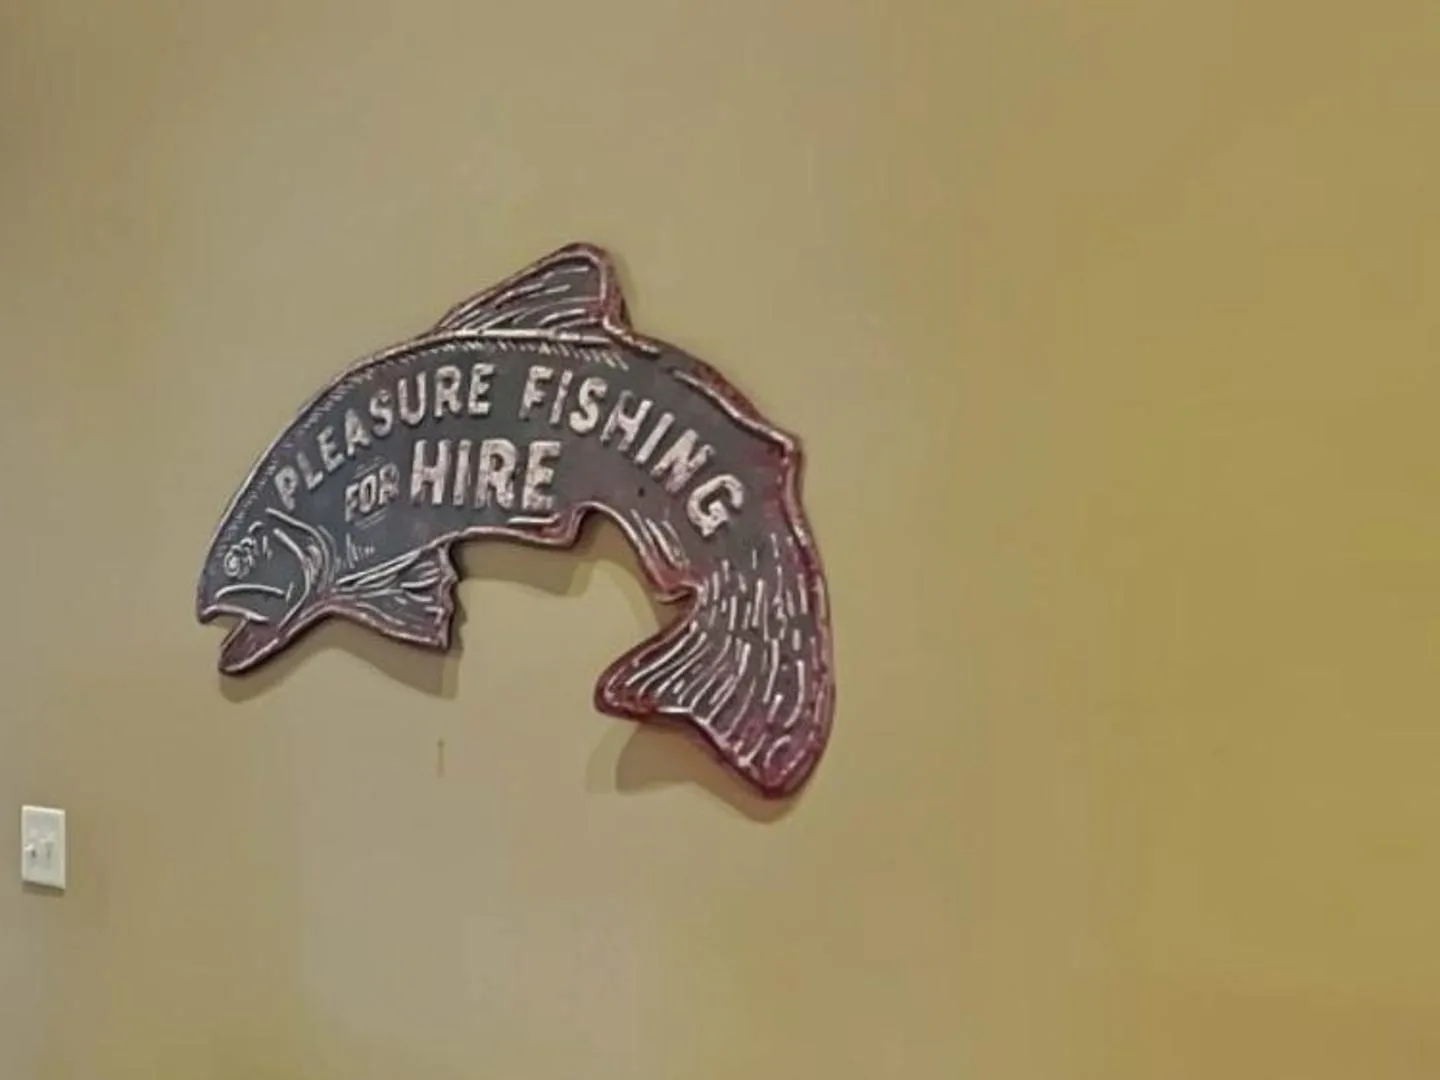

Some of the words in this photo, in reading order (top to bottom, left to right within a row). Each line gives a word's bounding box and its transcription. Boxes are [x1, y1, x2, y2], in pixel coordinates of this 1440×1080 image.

[274, 363, 494, 510] PLEASURE
[518, 365, 744, 537] FISHING
[345, 463, 400, 521] FOR
[411, 437, 561, 510] HIRE
